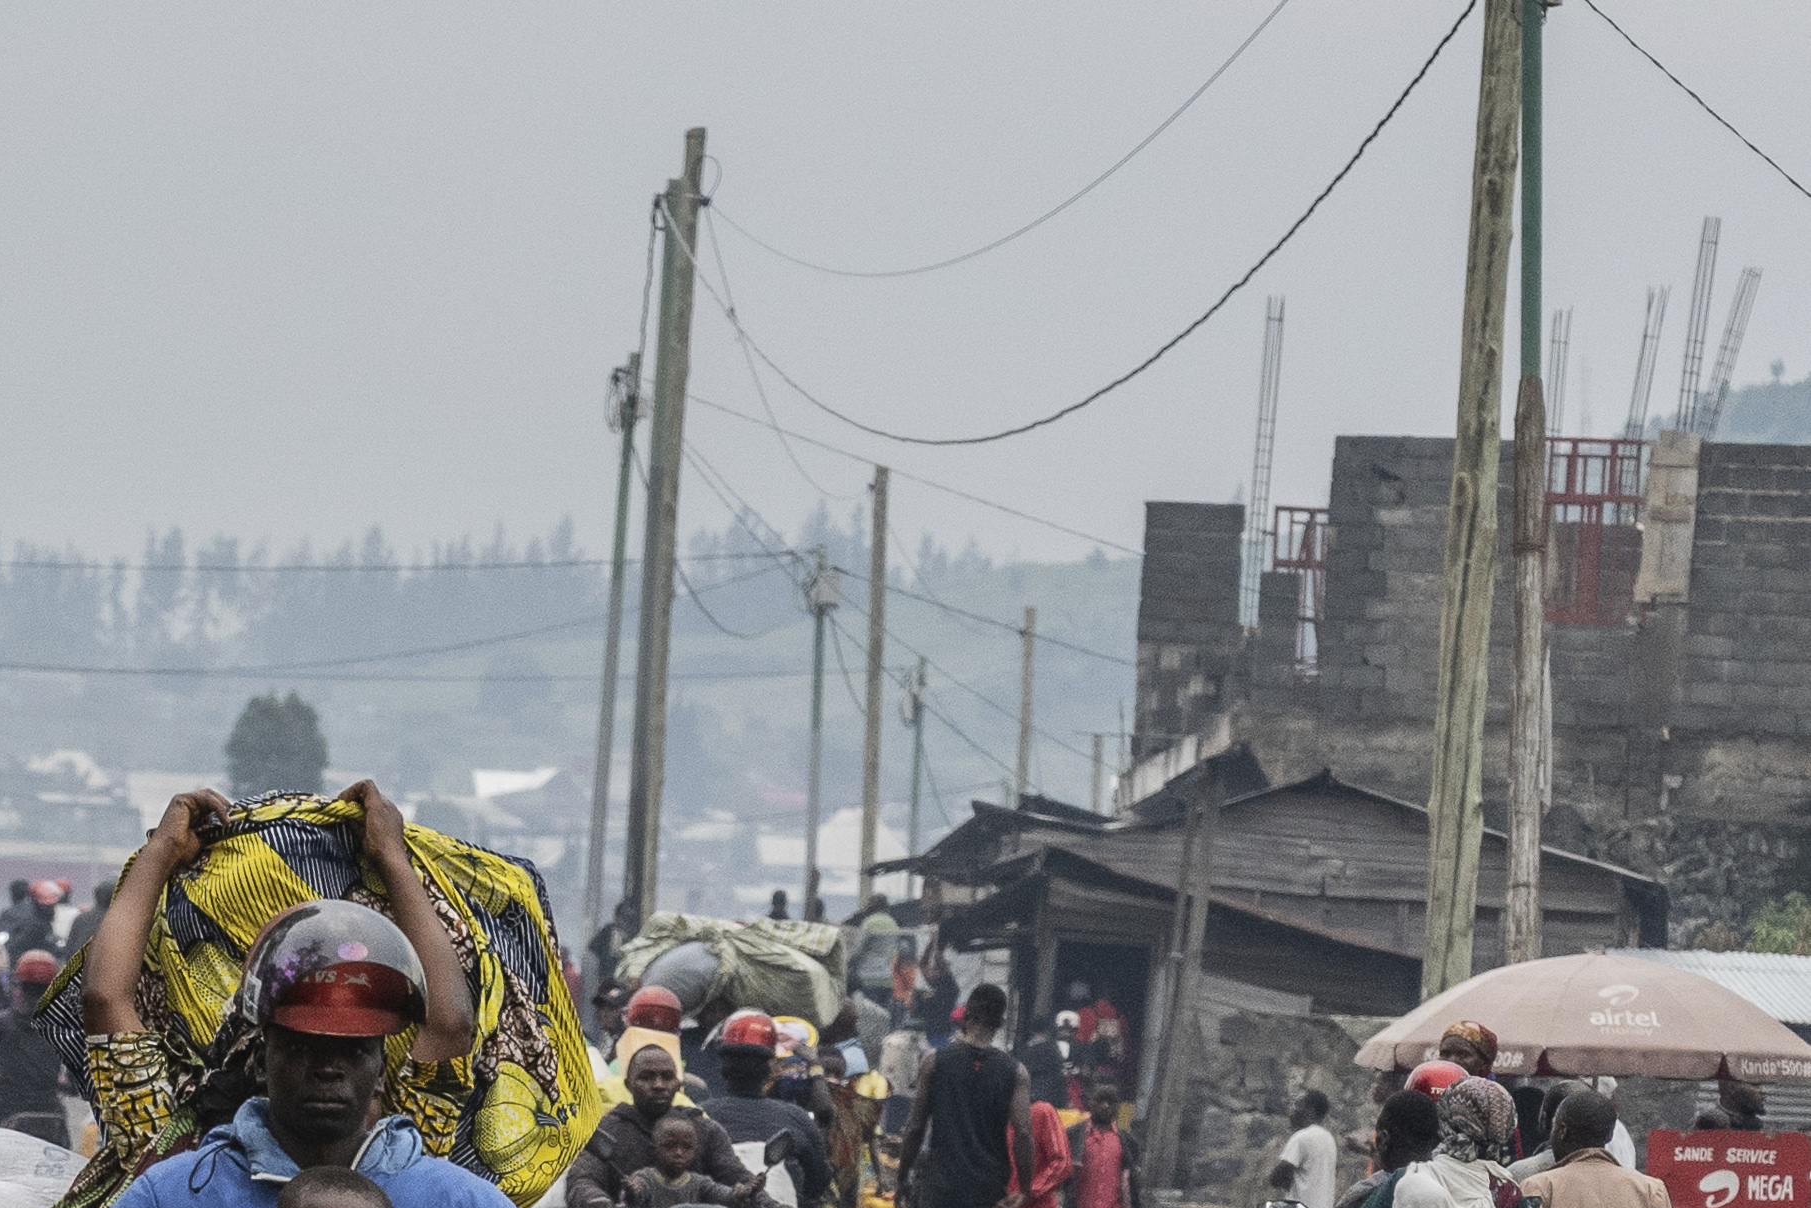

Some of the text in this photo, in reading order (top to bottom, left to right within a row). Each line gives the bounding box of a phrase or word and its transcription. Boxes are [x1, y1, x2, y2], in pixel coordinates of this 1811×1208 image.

[1590, 1006, 1661, 1027] airtel
[1674, 1147, 1777, 1165] SANDE SERVICE
[1748, 1175, 1793, 1201] MEGA
